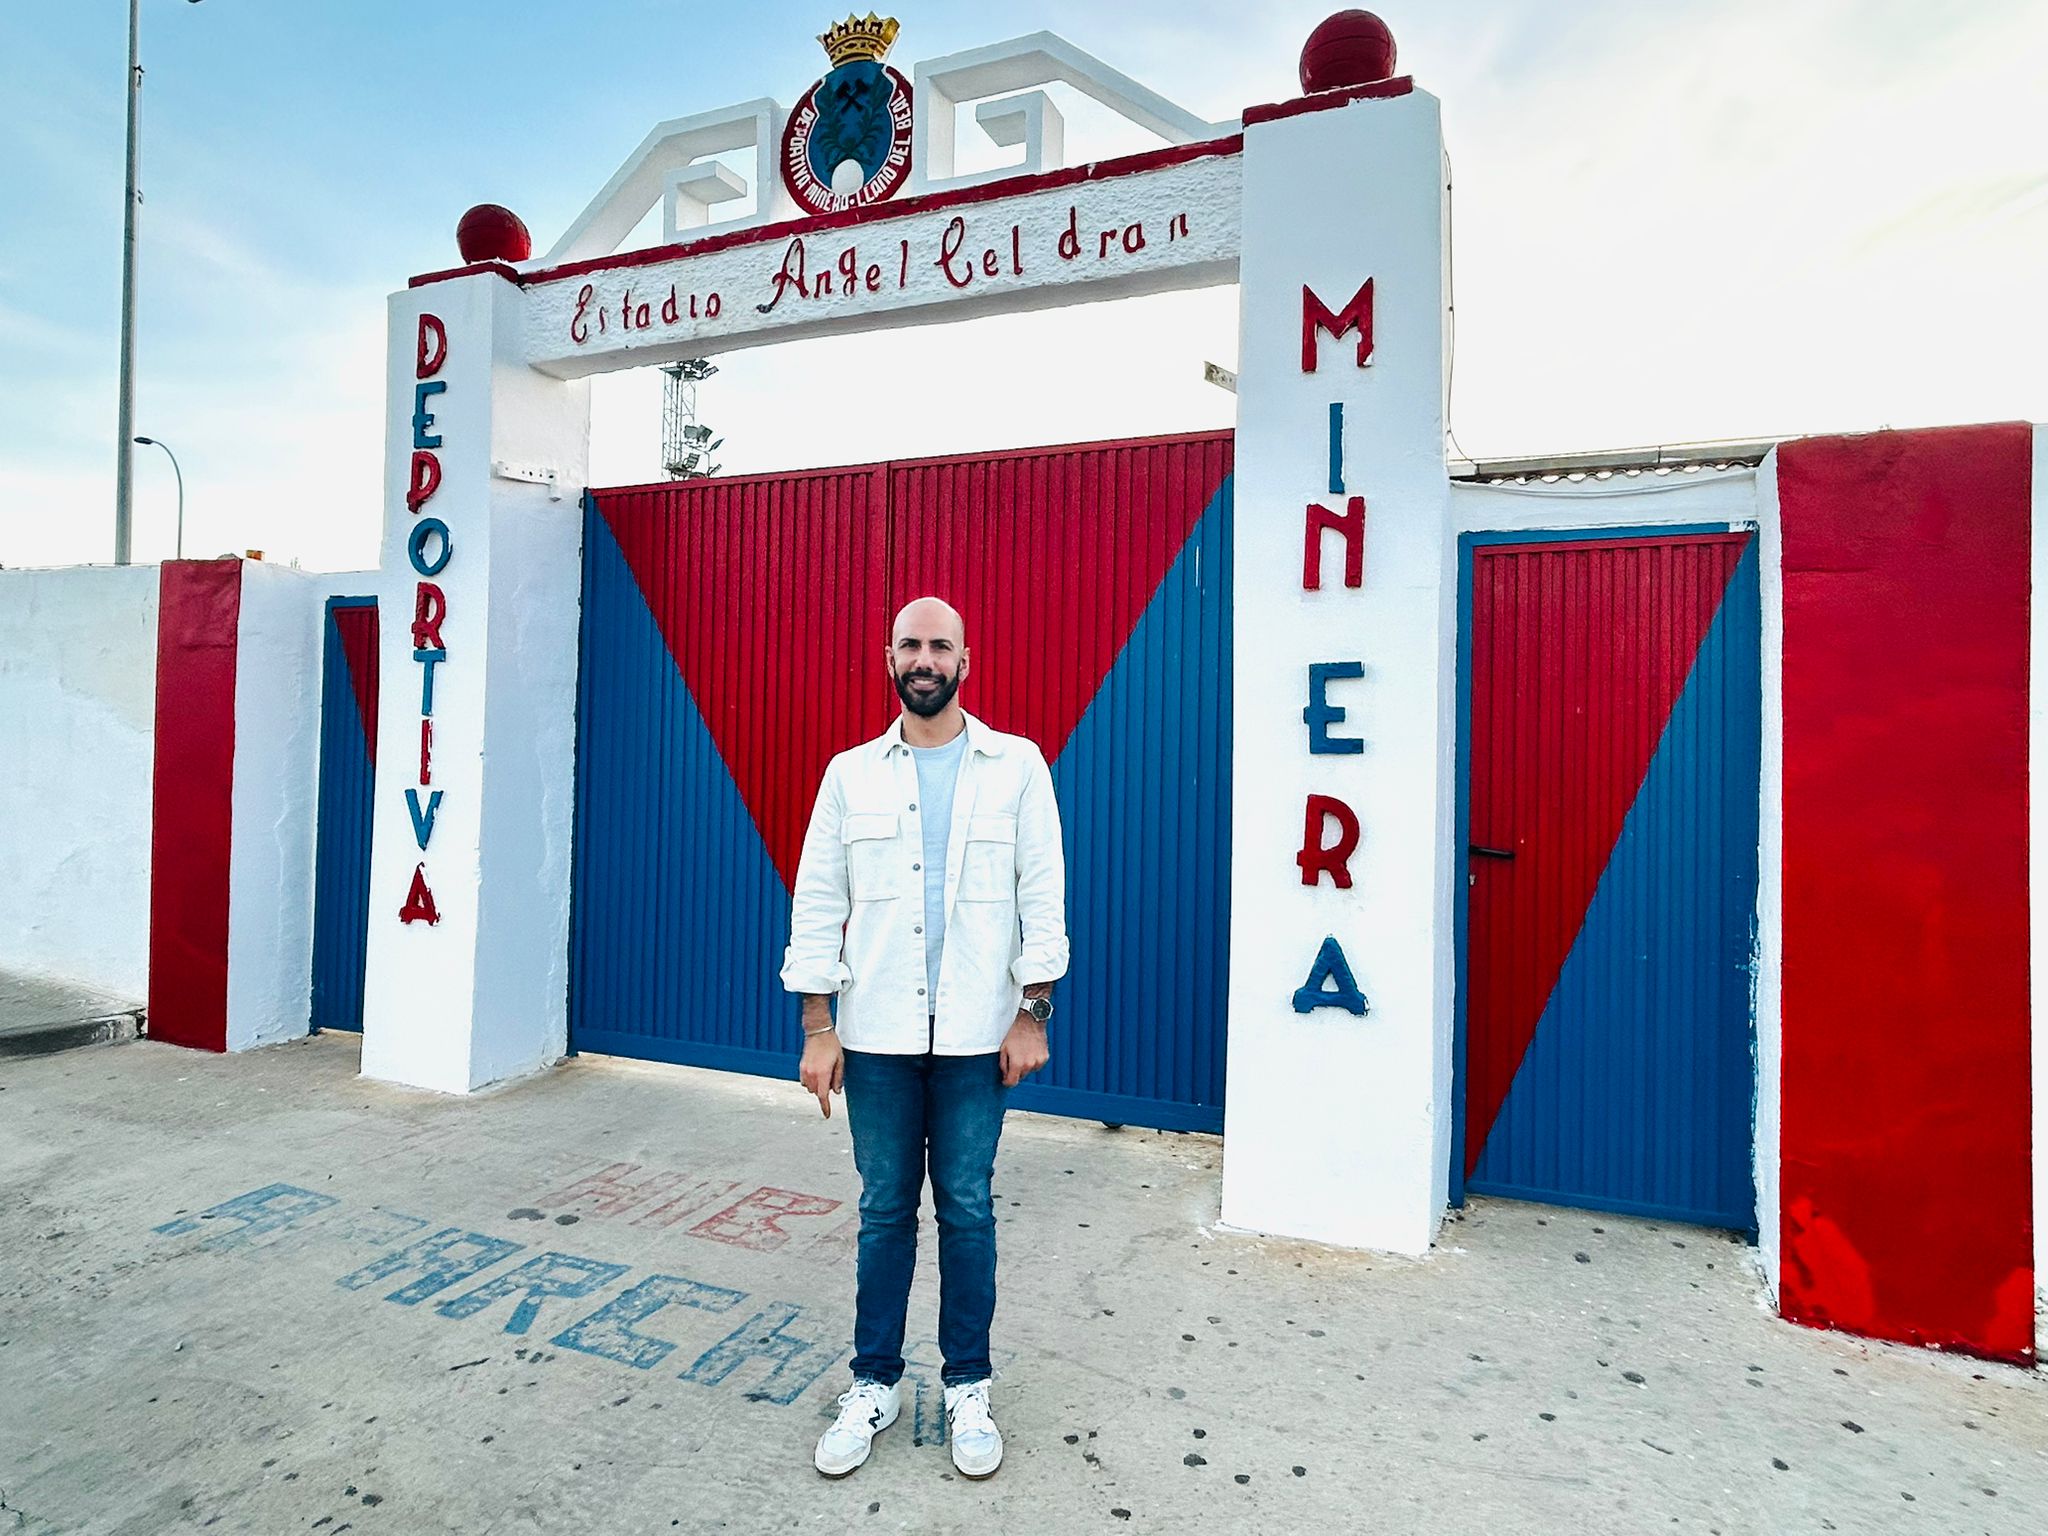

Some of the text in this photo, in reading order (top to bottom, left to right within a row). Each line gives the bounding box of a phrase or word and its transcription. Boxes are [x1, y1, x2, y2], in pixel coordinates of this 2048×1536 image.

[891, 89, 912, 130] BEAL
[855, 165, 898, 207] LLANO
[889, 134, 911, 166] DEL
[570, 283, 722, 345] Estadio
[757, 238, 908, 314] Angel
[399, 313, 453, 926] DEPORTIVA
[1292, 276, 1373, 1016] MINERA
